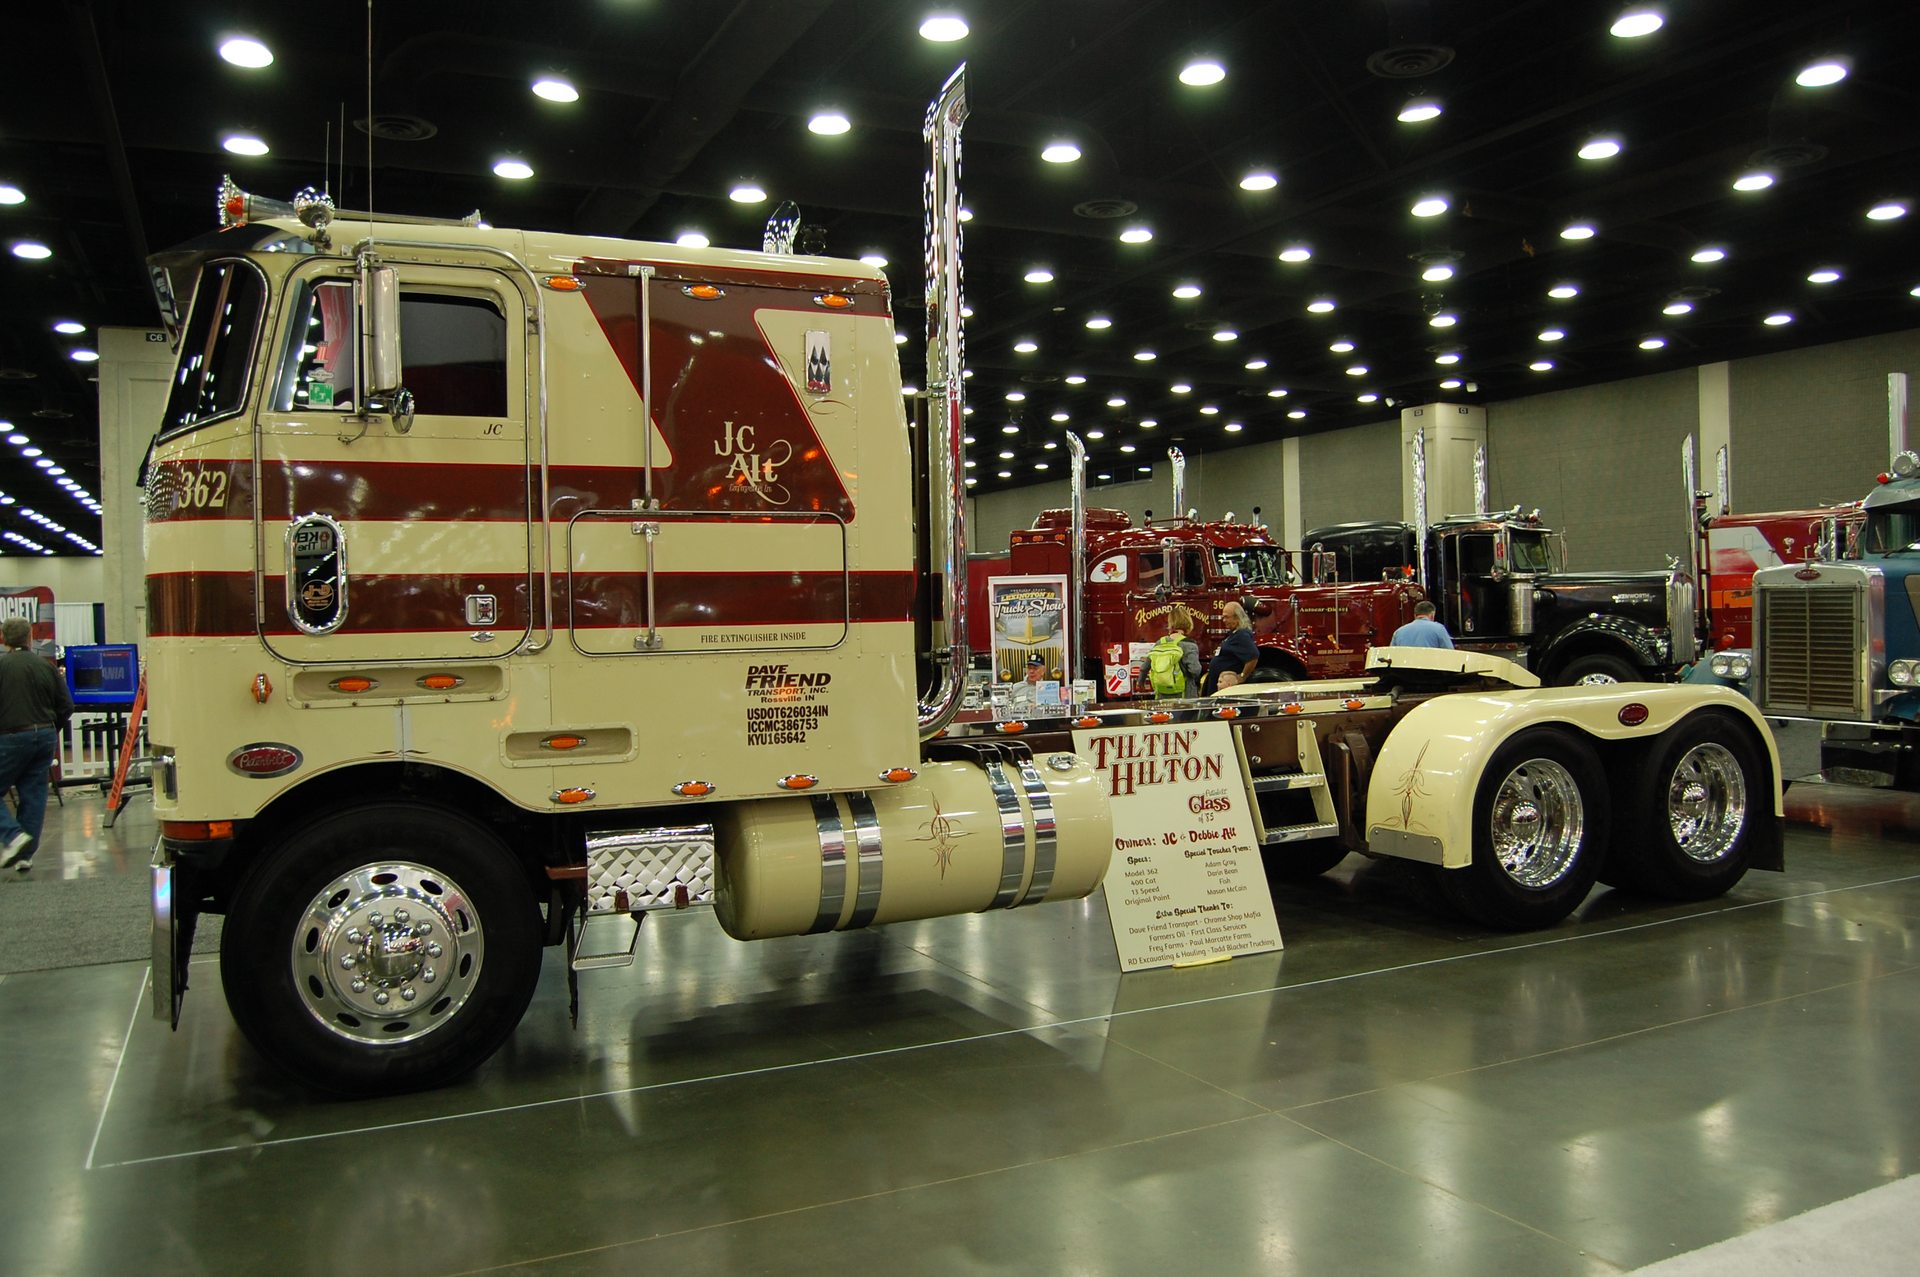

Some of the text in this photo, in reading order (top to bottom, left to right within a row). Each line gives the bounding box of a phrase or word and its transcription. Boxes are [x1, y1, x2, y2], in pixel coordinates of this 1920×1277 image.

[150, 333, 163, 342] C6
[483, 423, 503, 435] JC
[714, 421, 755, 456] JC
[178, 470, 227, 509] 362
[992, 599, 1066, 618] Truck Show
[1135, 605, 1173, 627] HOWARD
[701, 631, 806, 643] FIRE EXTINGUISHER INSIDE
[748, 664, 788, 675] DAVE
[745, 673, 831, 689] FRIEND
[747, 687, 806, 696] TRANSPORT,
[747, 705, 829, 720] USDOT626034IN
[747, 718, 818, 733] ICCMC386753
[748, 731, 806, 746] KYU165642
[1089, 730, 1199, 770] TILTIN'
[240, 754, 291, 768] Peterbilt
[1109, 754, 1222, 797] HILTON
[1188, 795, 1231, 814] Class
[1115, 837, 1157, 851] Owners:
[1162, 832, 1178, 845] JC
[1188, 830, 1220, 843] Debbie
[1221, 827, 1237, 840] Alt
[1184, 845, 1252, 859] Special Touches From:
[1127, 856, 1151, 865] Specs:
[1124, 869, 1145, 877] Model
[1207, 869, 1223, 877] Darin
[1139, 886, 1160, 896] Speed
[1124, 894, 1170, 906] Original Paint
[1156, 902, 1233, 919] Extra Special Thanks To:
[1129, 926, 1146, 934] Dave
[1147, 923, 1167, 932] Friend
[1168, 919, 1198, 929] Transport
[1204, 916, 1226, 924] Chrome
[1227, 914, 1242, 922] Shop
[1244, 911, 1261, 920] Mafia
[1149, 933, 1175, 941] Farmers
[1176, 929, 1186, 938] Oil
[1191, 927, 1205, 936] First
[1206, 926, 1222, 934] Class
[1223, 923, 1247, 932] Services
[1149, 944, 1164, 953] Frey
[1164, 942, 1184, 950] Farms
[1189, 938, 1204, 946] Paul
[1205, 935, 1232, 944] Marcotte
[1233, 932, 1251, 940] Farms
[1139, 954, 1174, 965] Excavating
[1181, 948, 1207, 957] Hauling
[1210, 945, 1225, 953] Todd
[1226, 942, 1249, 951] Blacker
[1249, 938, 1275, 948] Trucking
